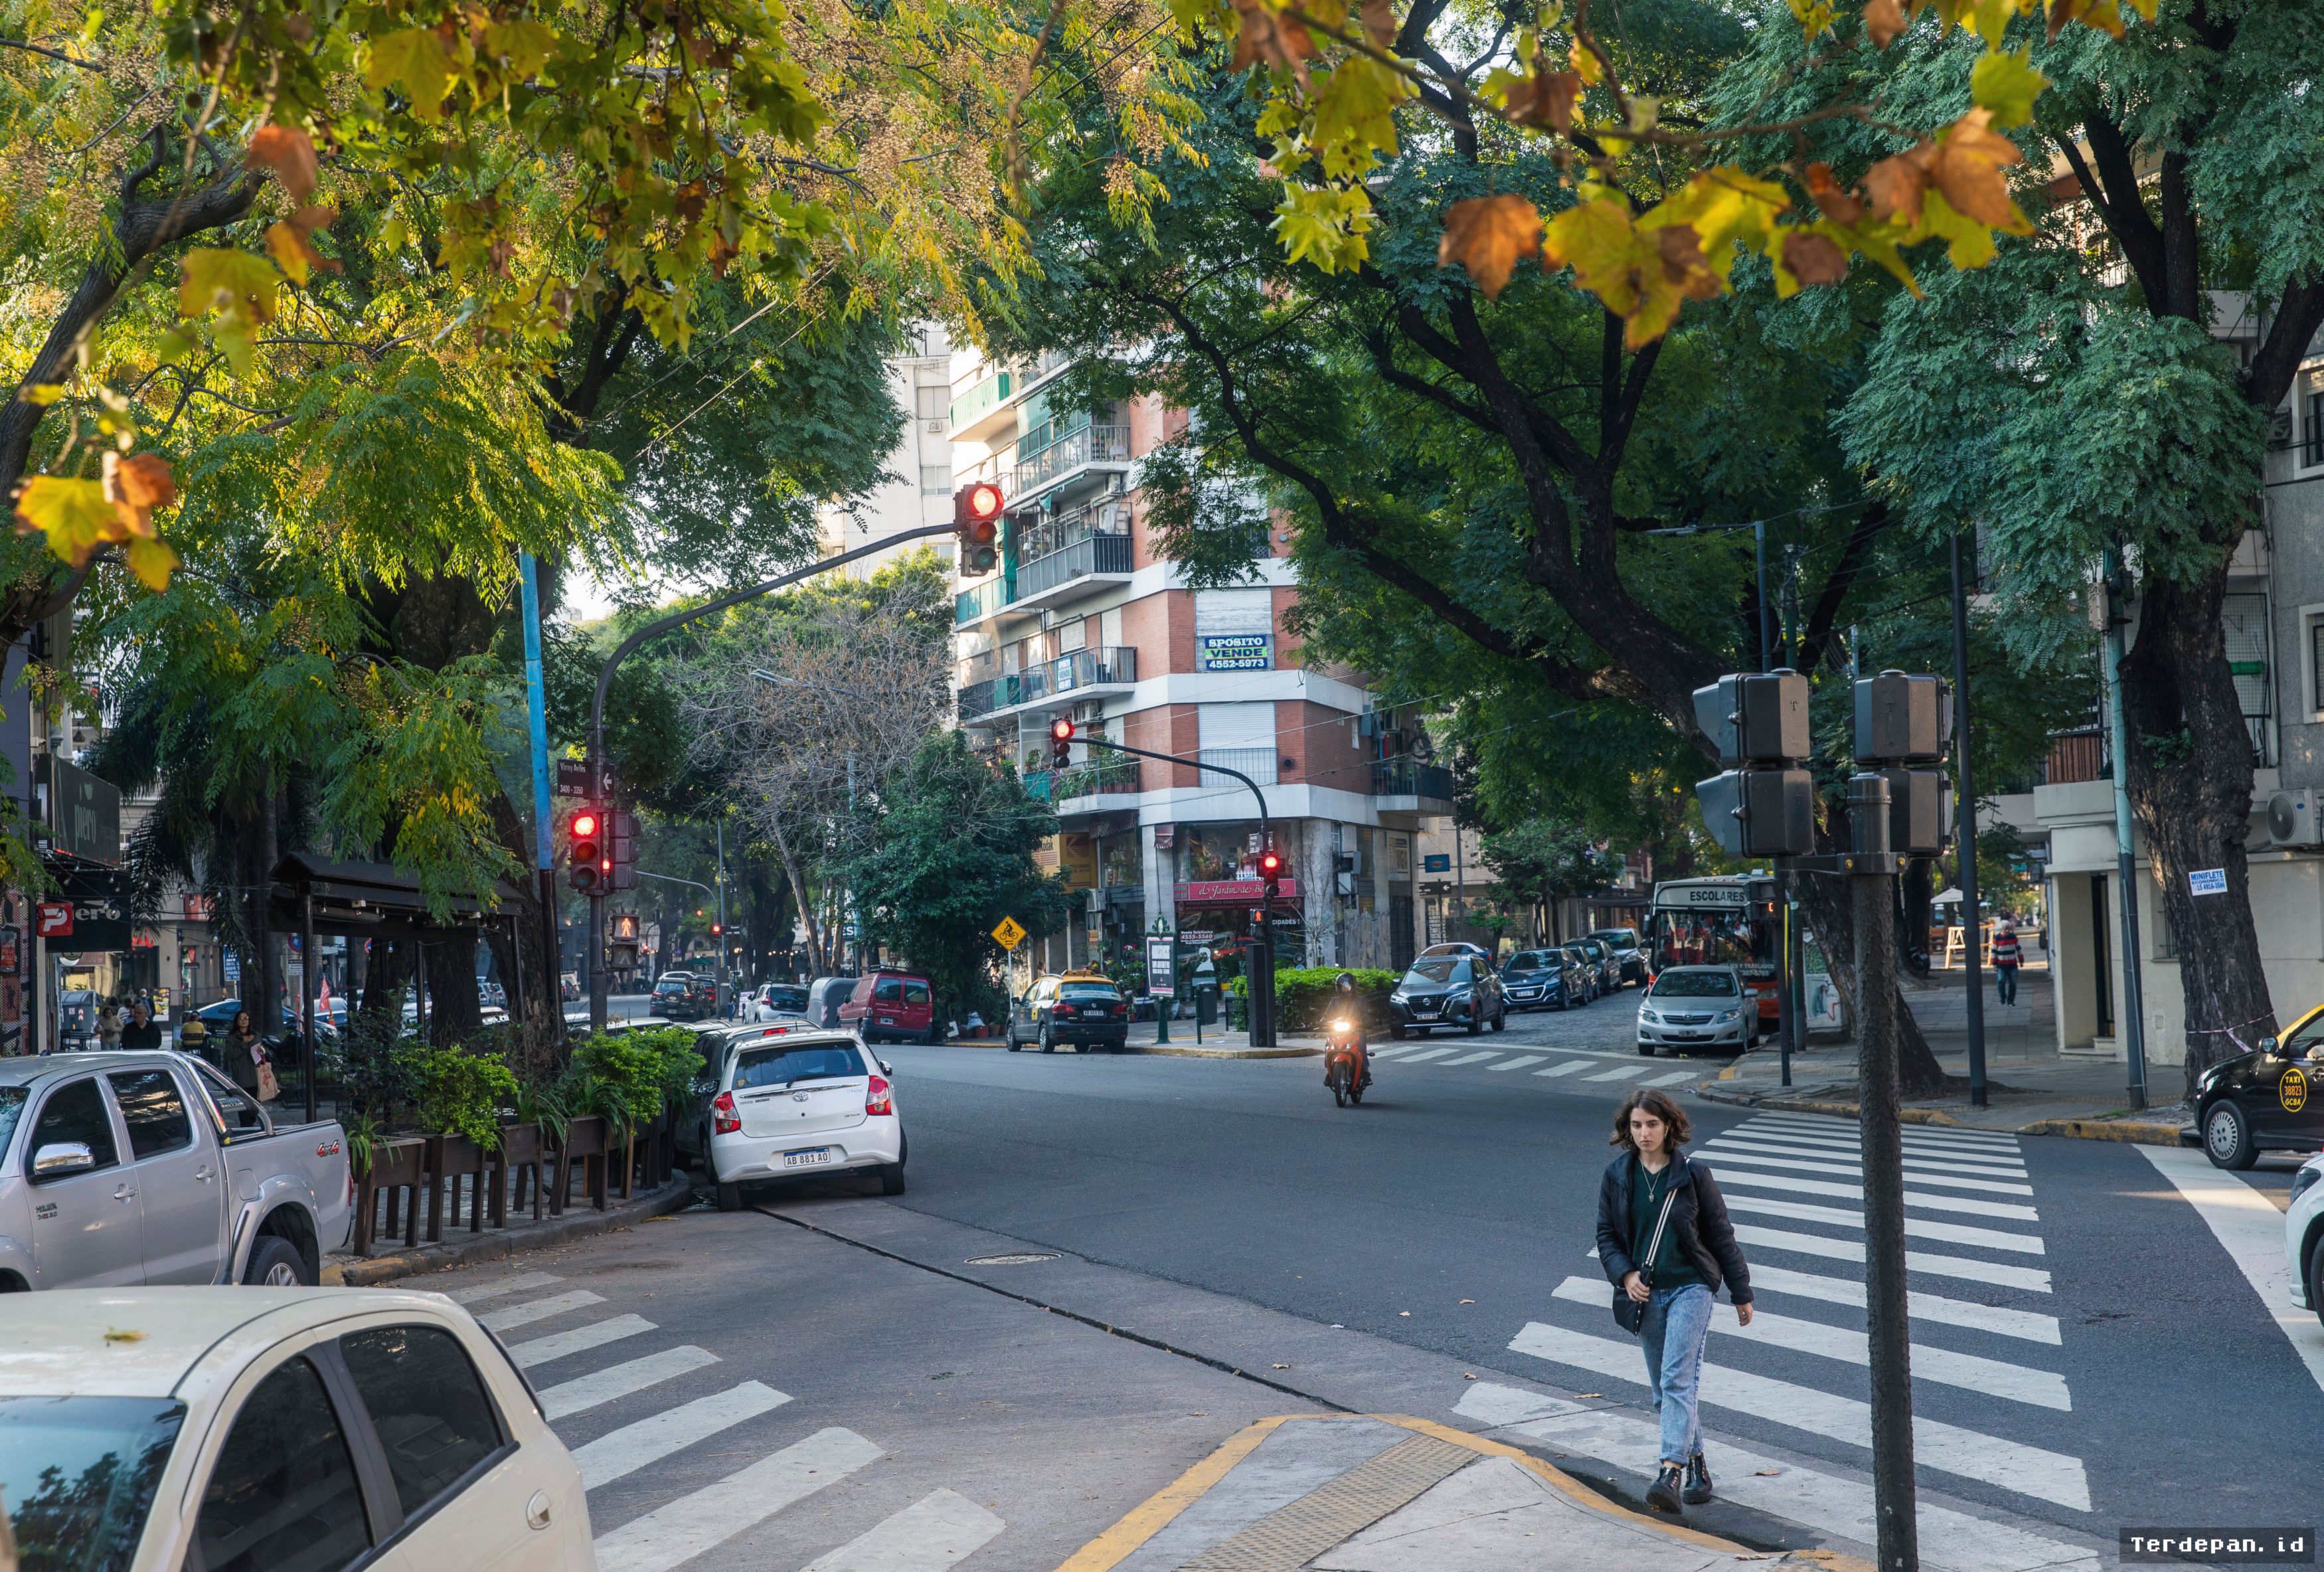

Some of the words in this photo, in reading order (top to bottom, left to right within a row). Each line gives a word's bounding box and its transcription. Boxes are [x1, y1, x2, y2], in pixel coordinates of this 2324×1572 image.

[1210, 648, 1264, 657] VENDE
[1209, 659, 1265, 668] 4552-5973
[560, 762, 573, 773] Virrey
[560, 784, 570, 794] 3400
[74, 804, 96, 851] piero
[2191, 871, 2224, 880] MINIFLETE
[1240, 883, 1252, 893] de
[1690, 891, 1745, 902] ESCOLARES
[2284, 1085, 2302, 1096] 38823
[316, 1139, 340, 1158] 4x4
[787, 1156, 797, 1166] AB
[800, 1154, 815, 1164] 881
